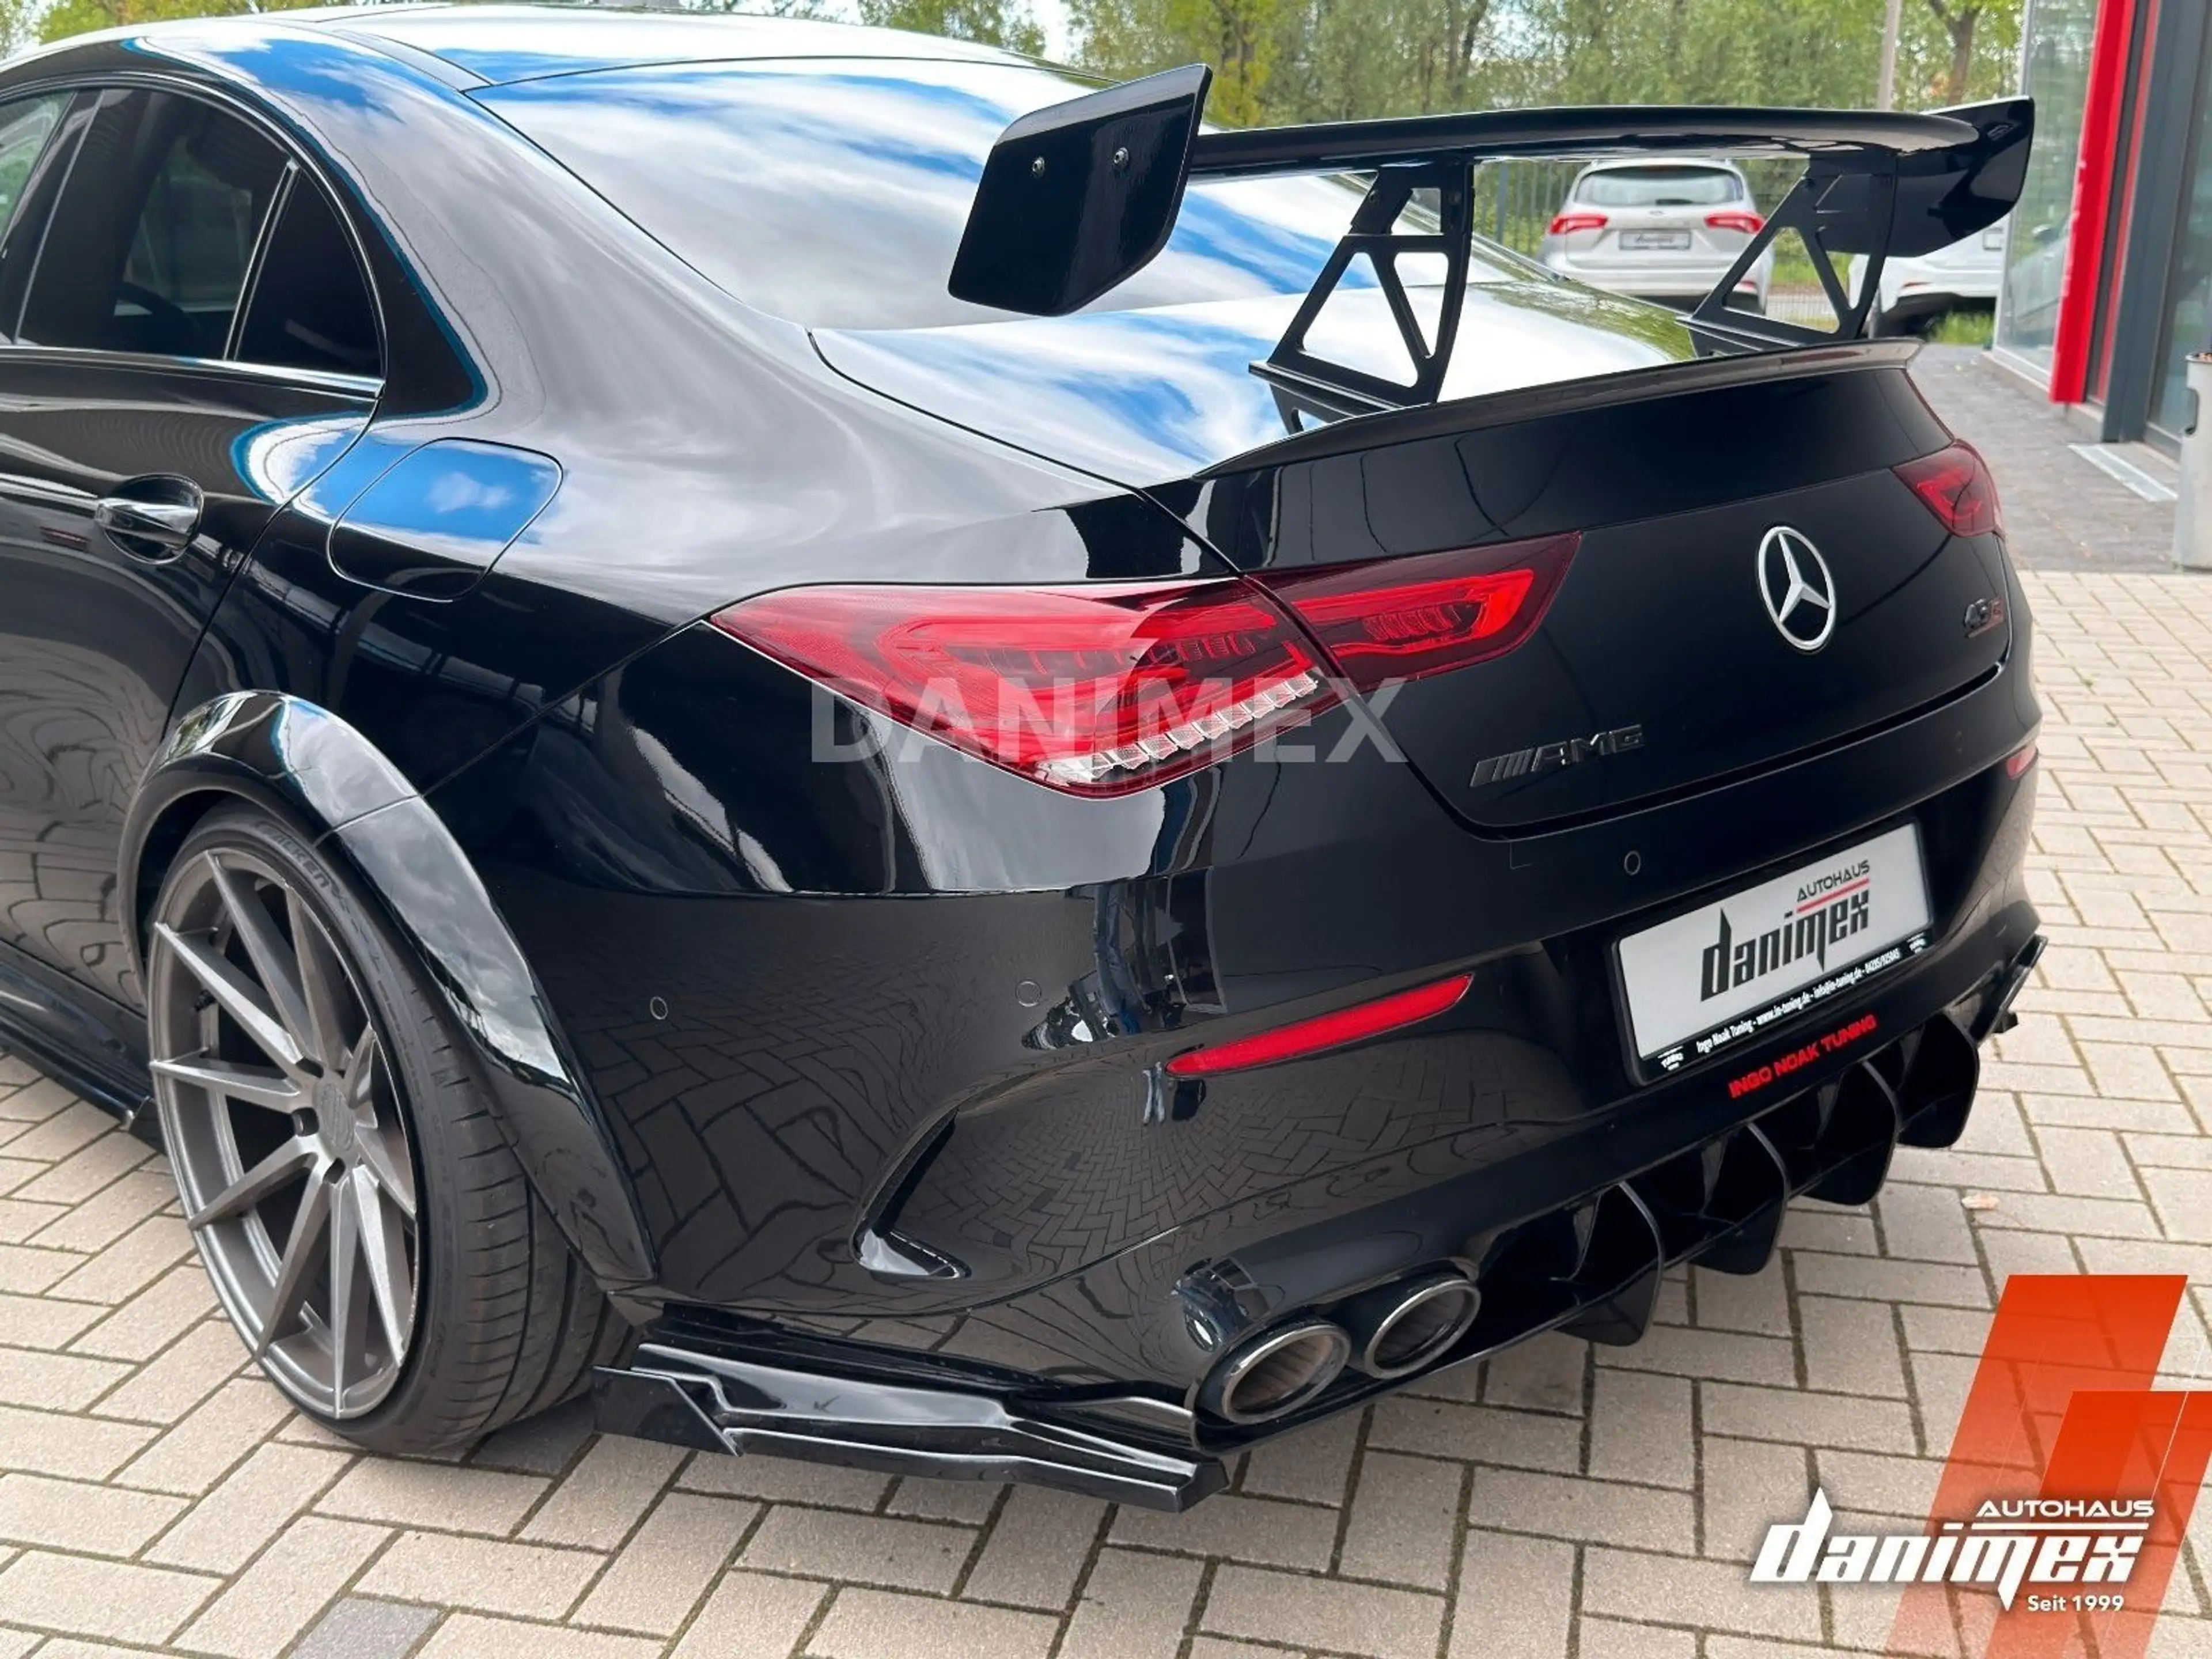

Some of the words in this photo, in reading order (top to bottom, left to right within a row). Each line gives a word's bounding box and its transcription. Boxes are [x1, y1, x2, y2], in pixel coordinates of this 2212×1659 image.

[1797, 859, 1870, 903] AUTOHAUS
[1700, 889, 1870, 1002] danimex
[1729, 1066, 1772, 1099] INGO
[1773, 1042, 1820, 1077] NOAK
[1820, 1014, 1877, 1052] TUNING
